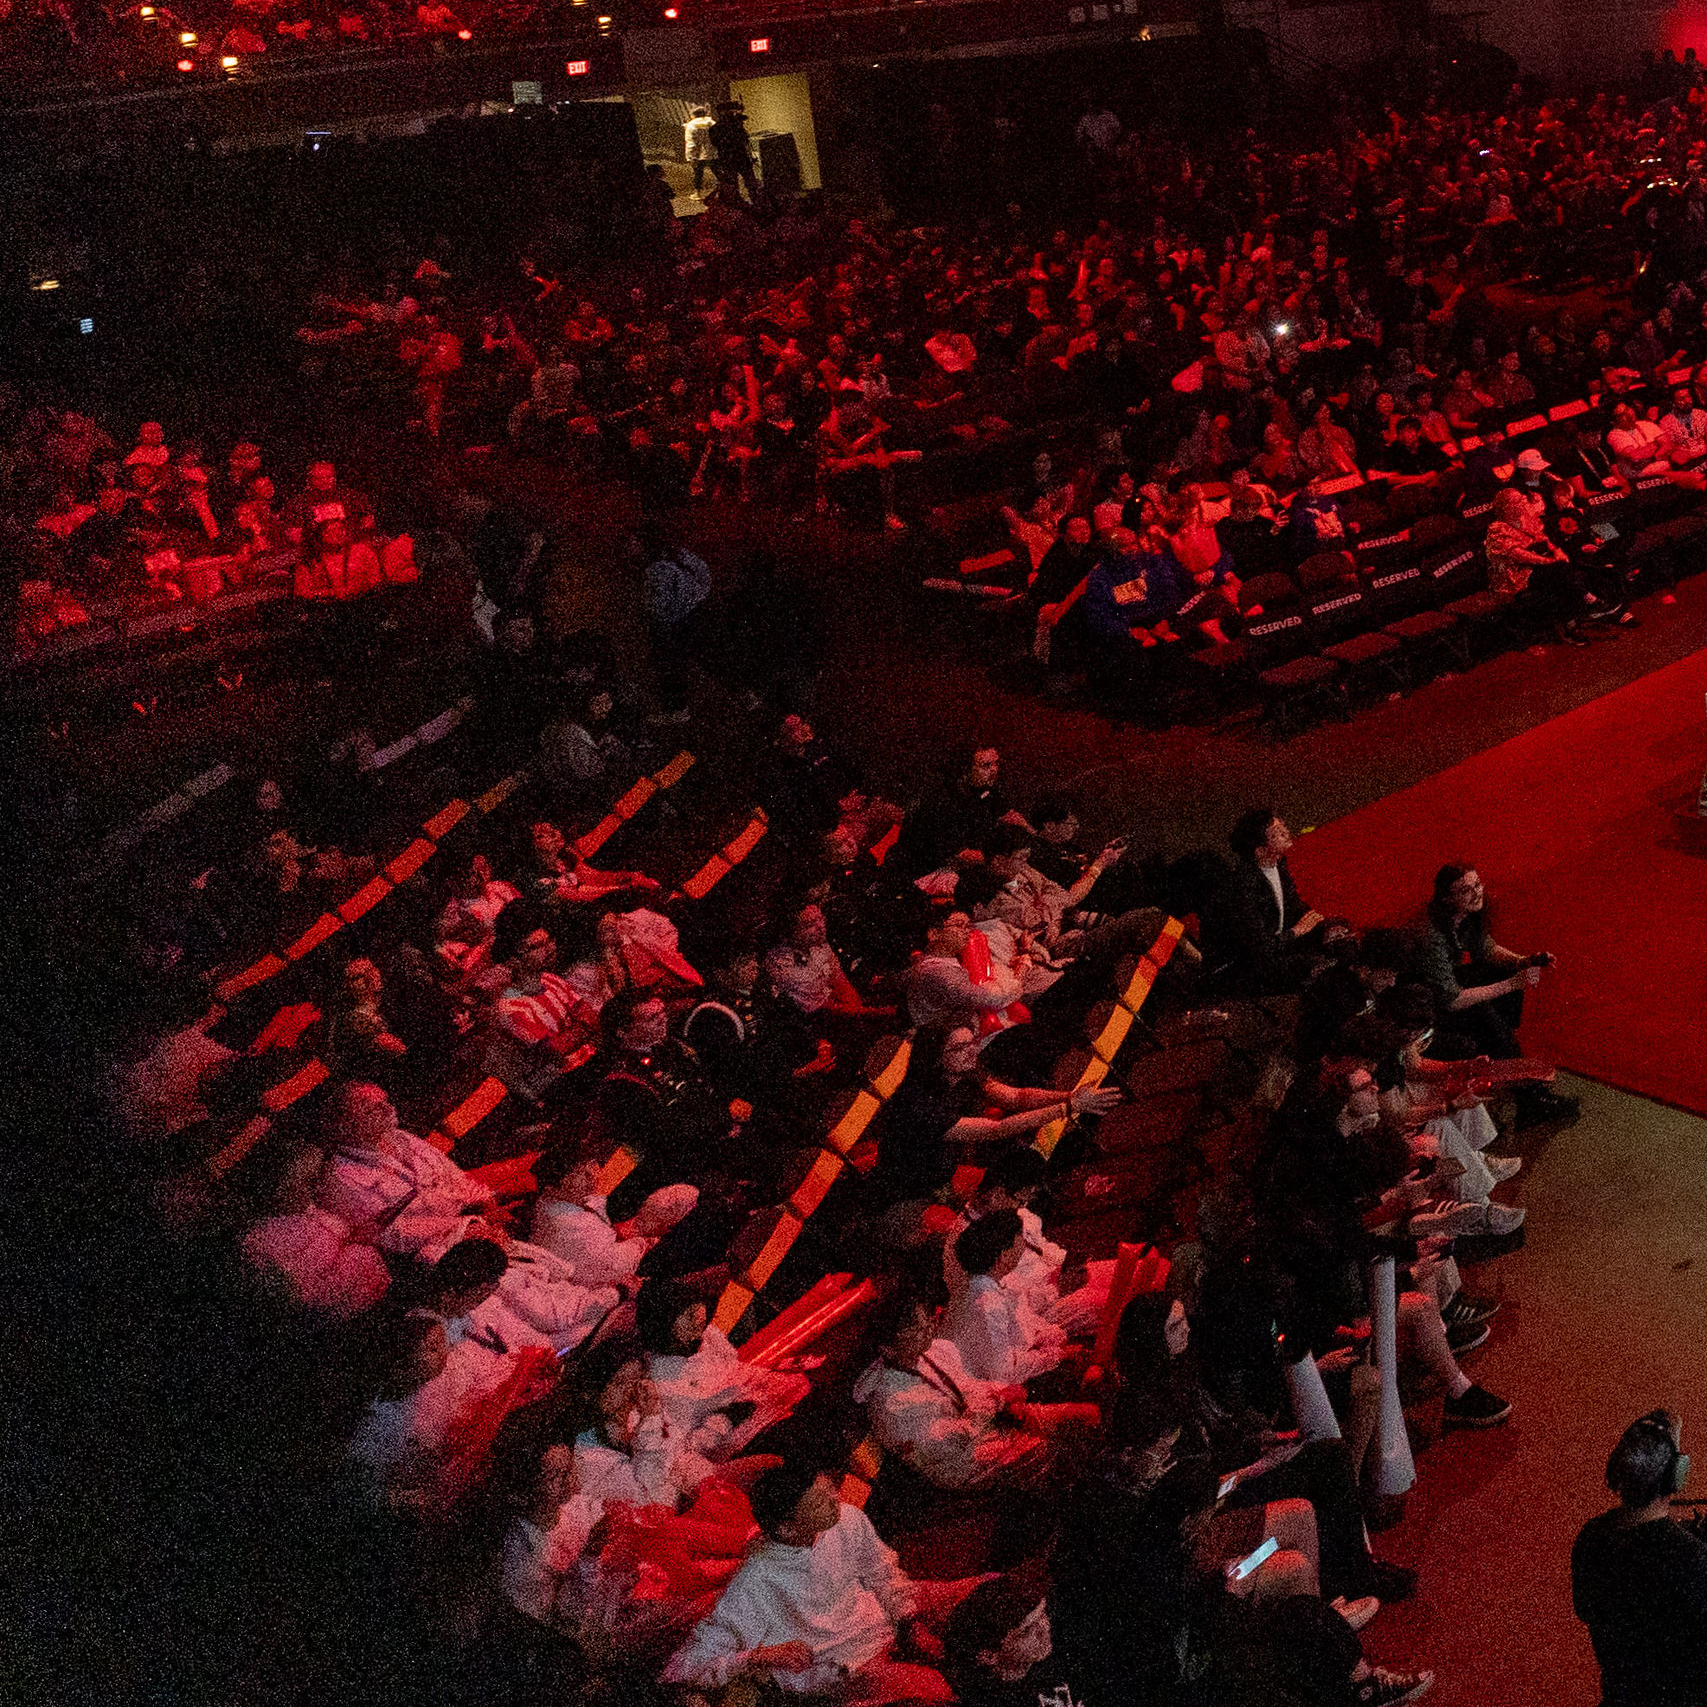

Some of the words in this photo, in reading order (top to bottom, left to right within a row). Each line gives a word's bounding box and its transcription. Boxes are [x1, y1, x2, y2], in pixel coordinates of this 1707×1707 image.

[1372, 567, 1420, 589] RESERVED
[1312, 593, 1362, 614] RESERVED
[1249, 615, 1302, 636] RESERVED
